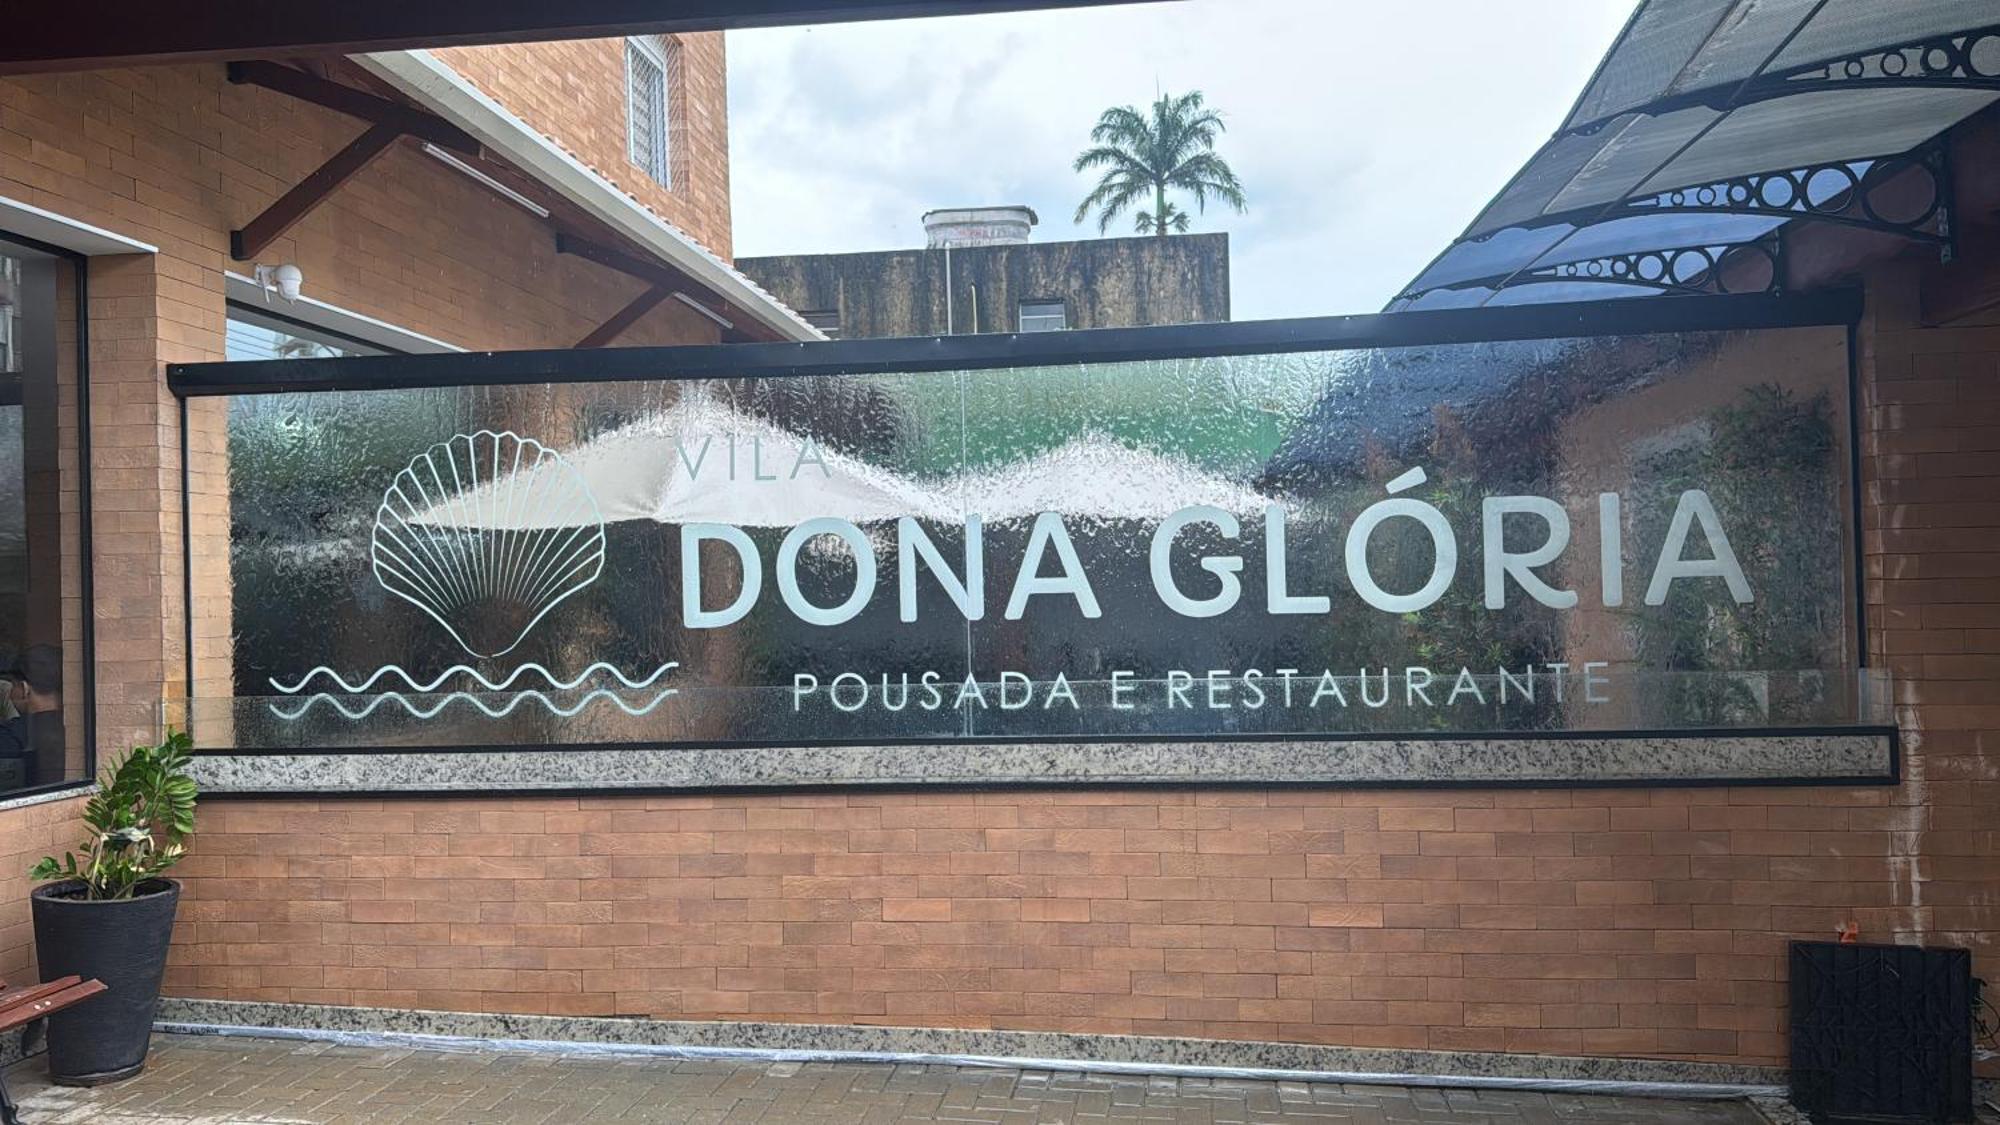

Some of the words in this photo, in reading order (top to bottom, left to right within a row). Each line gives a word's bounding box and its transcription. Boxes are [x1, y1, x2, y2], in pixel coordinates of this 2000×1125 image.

[673, 434, 831, 481] VILA
[681, 512, 1101, 629] DONA
[1150, 466, 1754, 617] GLÓRIA
[793, 670, 1080, 711] POUSADA
[1111, 670, 1135, 709] E
[1167, 661, 1610, 710] RESTAURANTE
